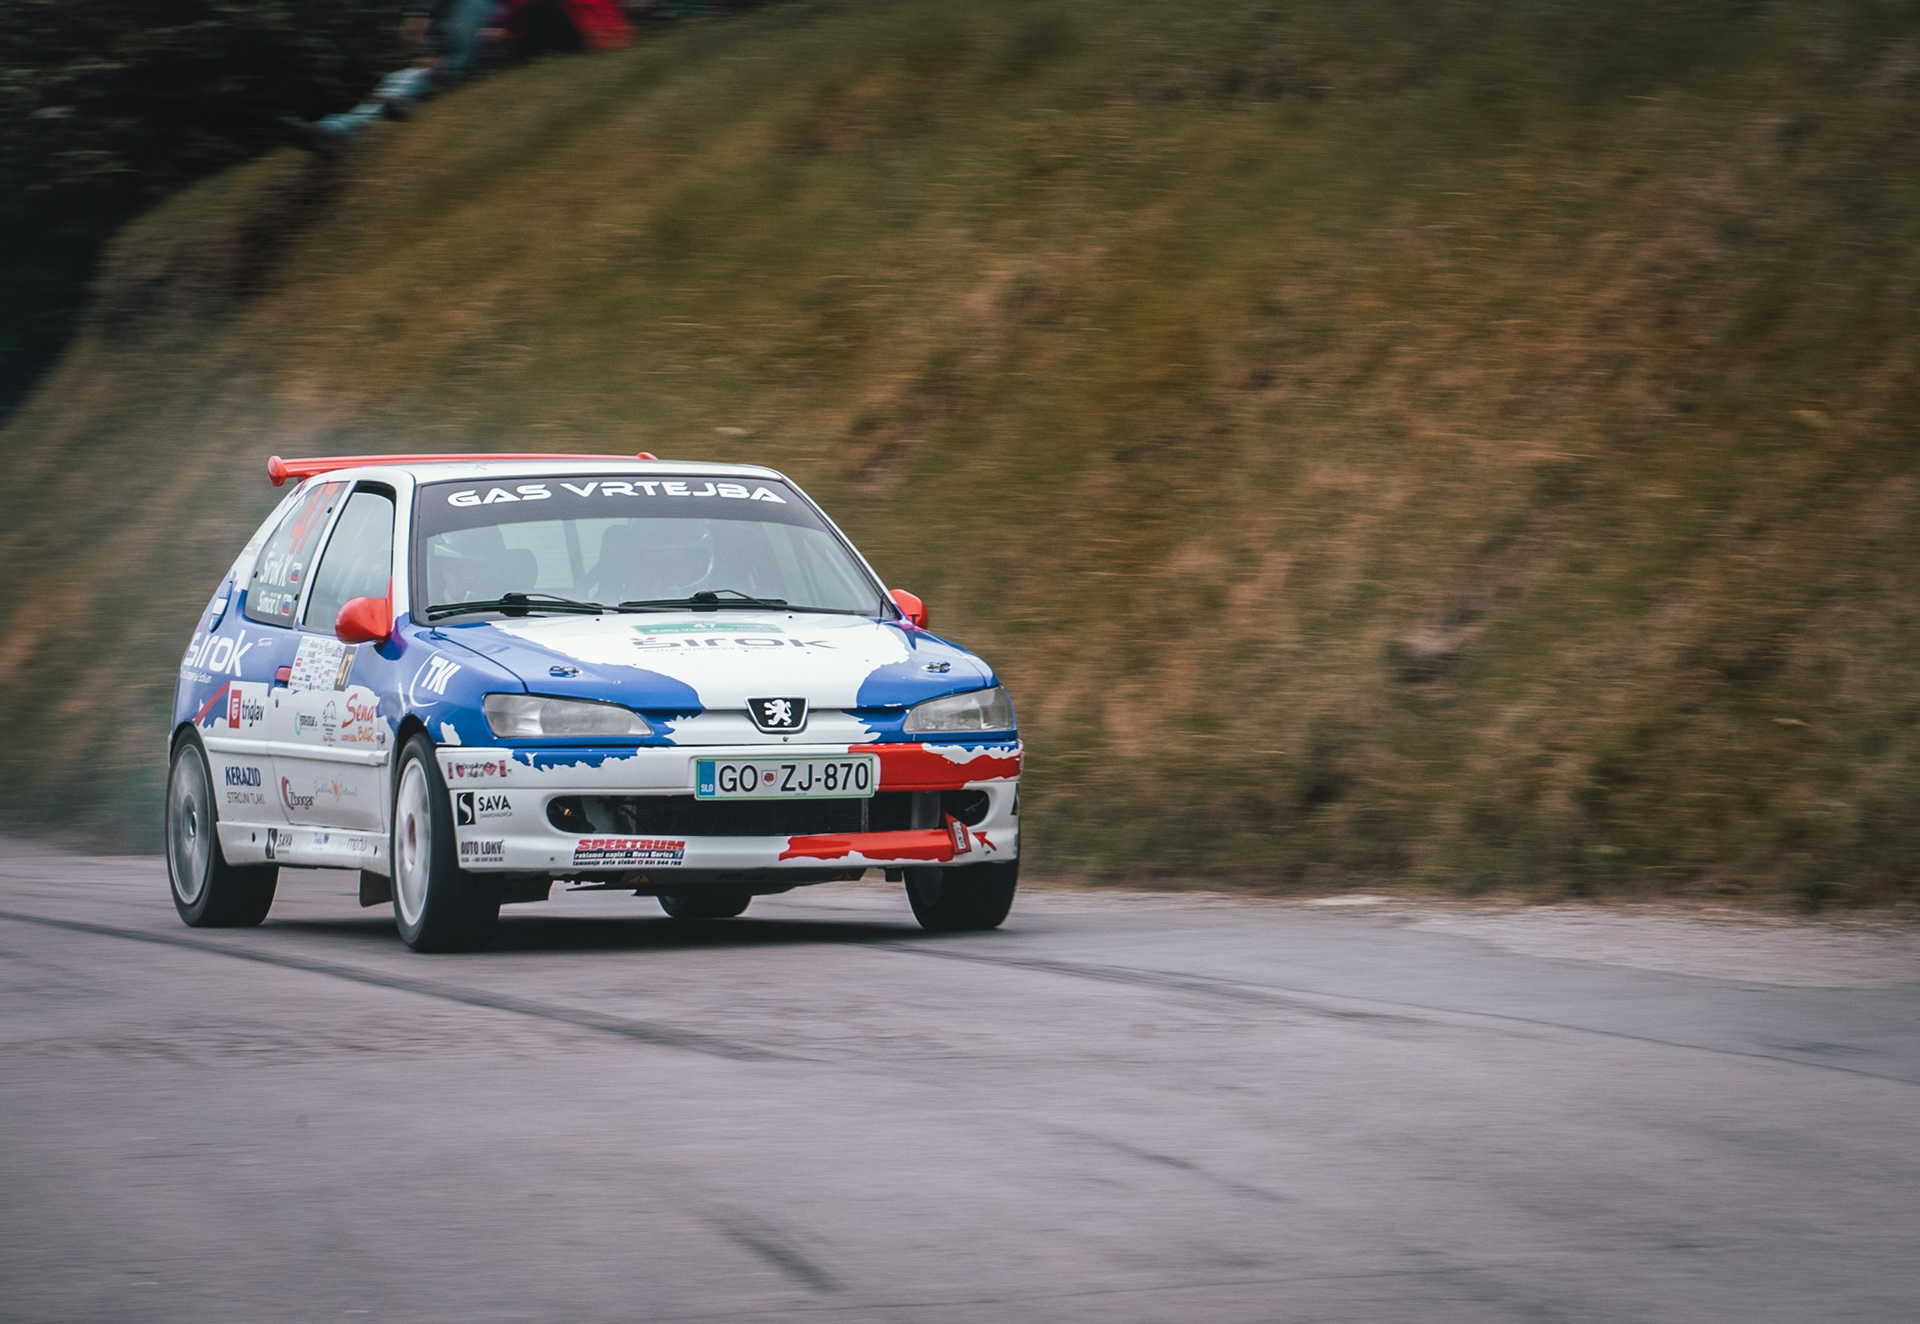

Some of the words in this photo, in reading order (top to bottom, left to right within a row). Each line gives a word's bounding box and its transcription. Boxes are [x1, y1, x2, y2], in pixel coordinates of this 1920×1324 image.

[447, 484, 552, 507] GAS
[560, 481, 787, 504] VRTEJBA
[242, 699, 264, 728] triglav
[341, 693, 375, 728] Sena
[225, 766, 262, 787] KERAZID
[701, 784, 714, 792] SLO
[719, 764, 758, 793] GO
[780, 762, 869, 792] ZJ-870
[478, 795, 512, 812] SAVA
[577, 839, 686, 850] SPEKTRUM
